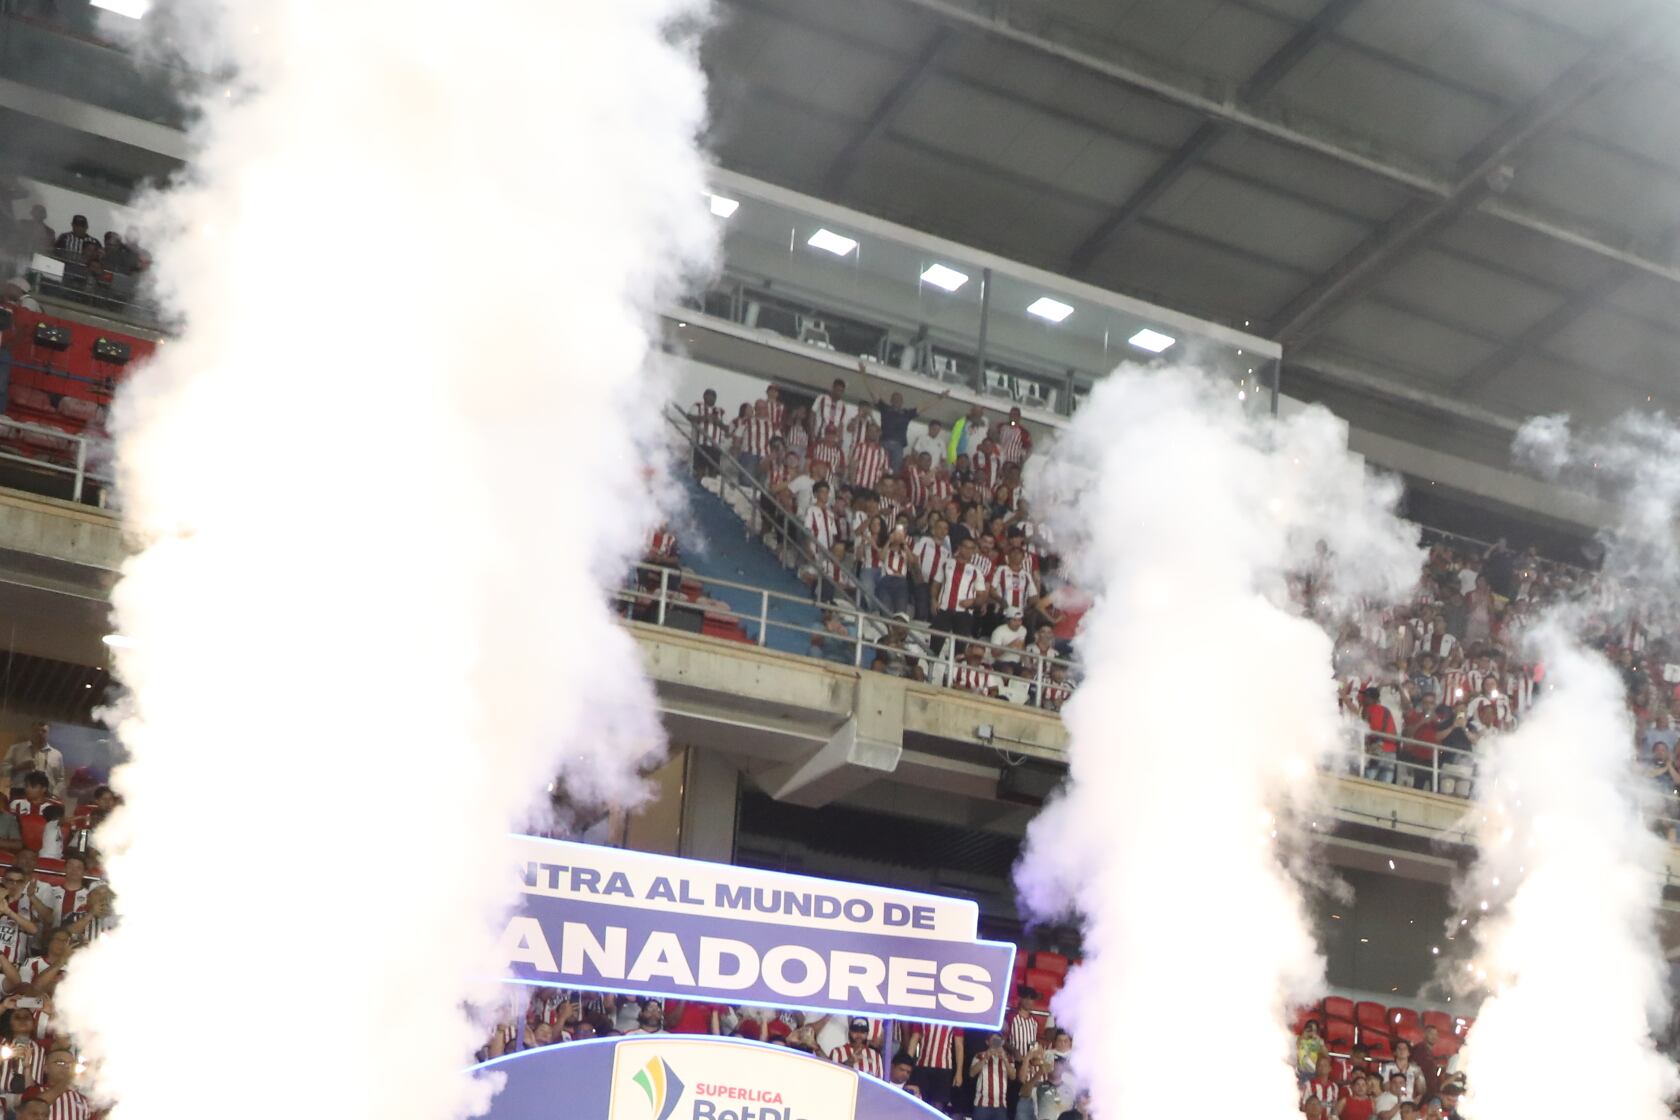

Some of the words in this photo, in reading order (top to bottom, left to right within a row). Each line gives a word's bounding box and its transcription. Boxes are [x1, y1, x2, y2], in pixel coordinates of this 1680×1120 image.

[518, 861, 636, 899] NTRA
[645, 876, 706, 907] AL
[714, 883, 875, 924] MUNDO
[882, 905, 937, 932] DE
[501, 915, 995, 1015] ANADORES
[695, 1082, 784, 1106] SUPERLIGA
